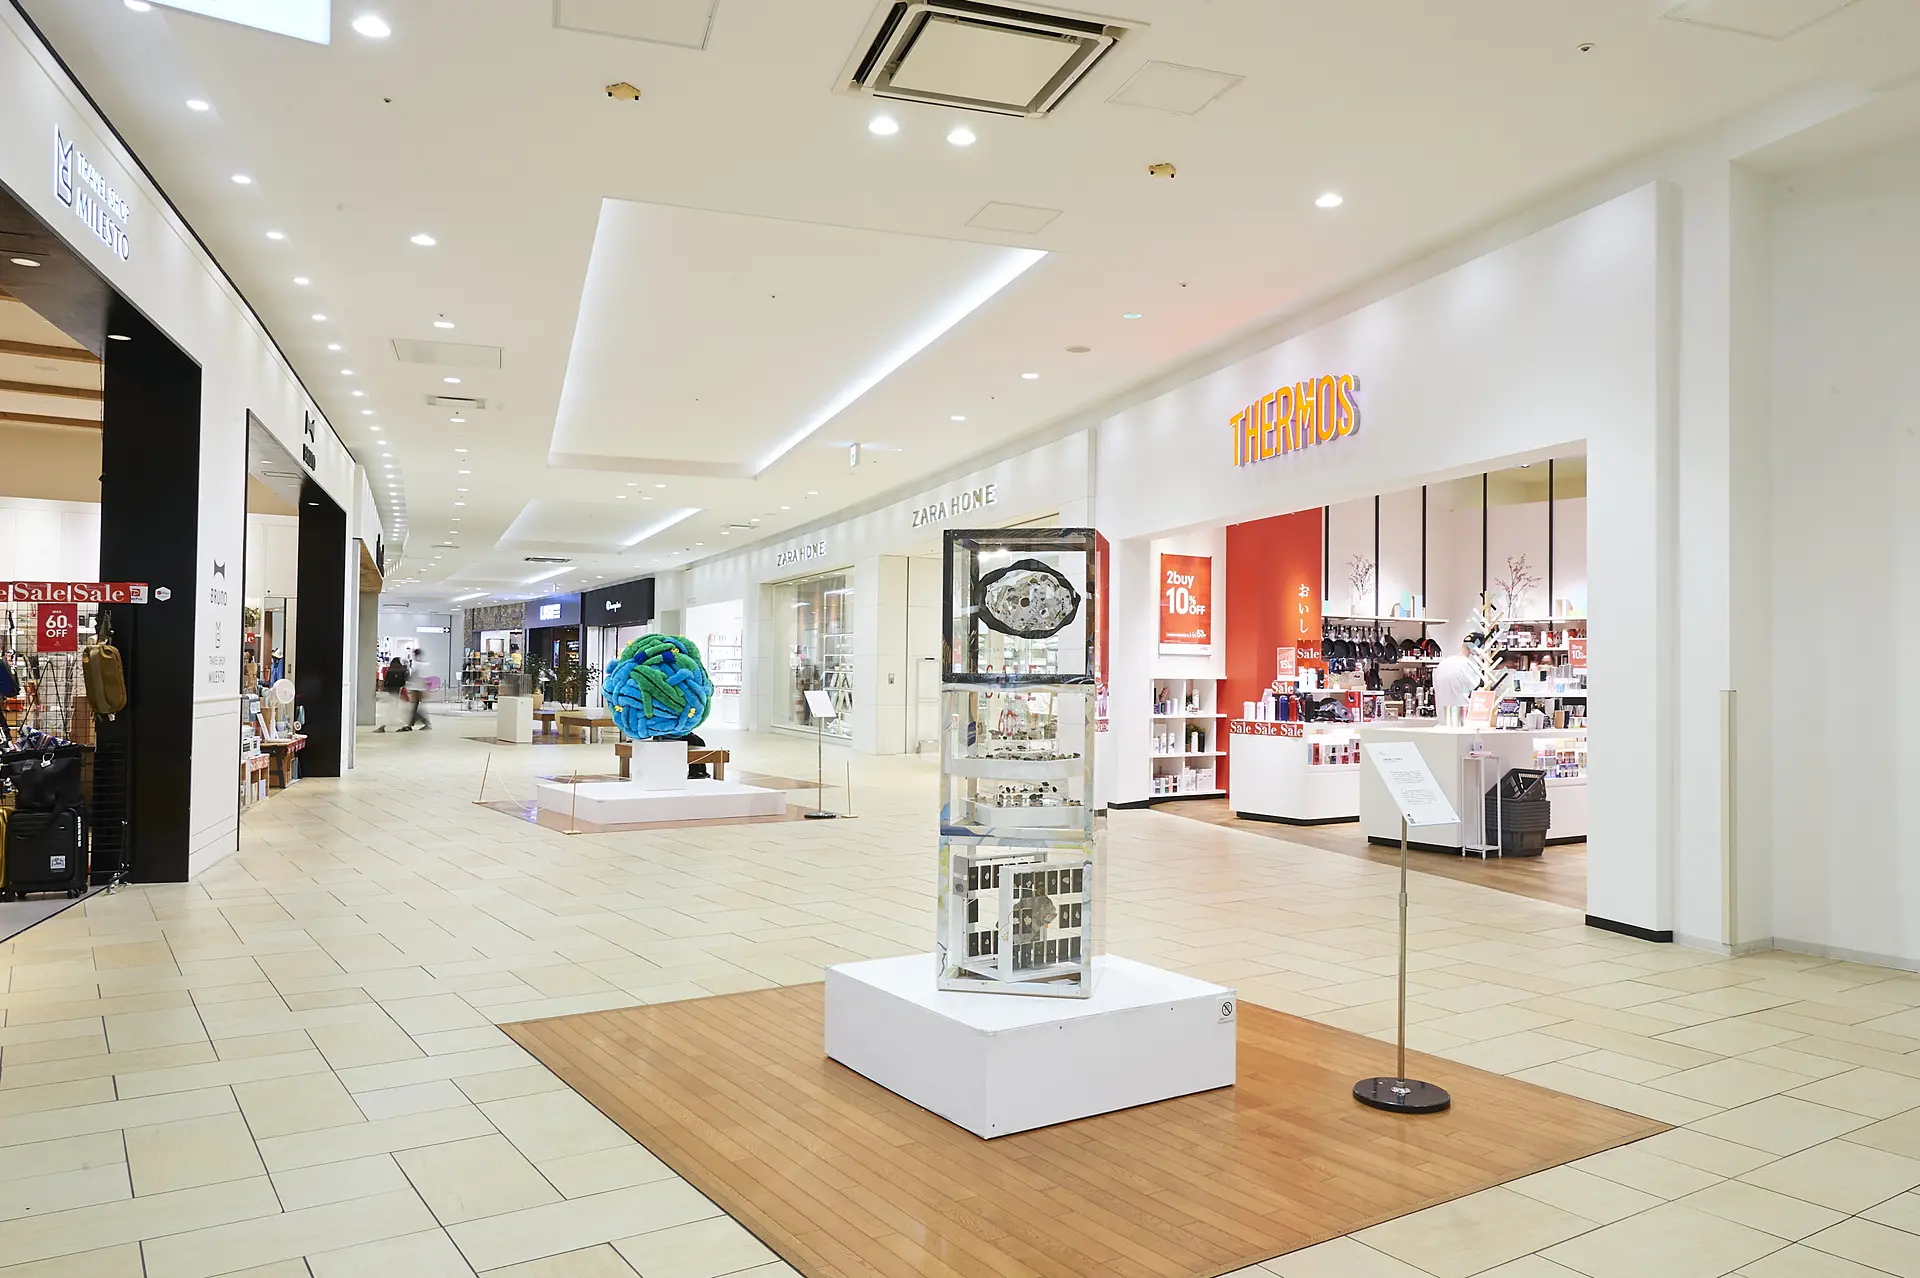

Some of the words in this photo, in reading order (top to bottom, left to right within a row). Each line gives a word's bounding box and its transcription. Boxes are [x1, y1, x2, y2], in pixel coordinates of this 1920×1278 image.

[77, 151, 107, 202] TRAVEL
[108, 187, 130, 224] SHOP
[75, 187, 129, 261] MILESTO
[1230, 373, 1357, 467] THERMOS
[912, 502, 948, 528] ZARA
[951, 484, 997, 515] HOME
[777, 550, 799, 567] ZARA
[1166, 570, 1194, 588] 2buy
[14, 582, 66, 601] Sale
[73, 583, 125, 602] Sale
[1189, 605, 1206, 615] OFF
[1298, 583, 1310, 642] おいし
[45, 615, 73, 629] 60%
[46, 629, 68, 638] OFF
[1297, 648, 1320, 659] Sale
[1271, 682, 1294, 694] Sale
[1230, 721, 1252, 734] Sale
[1254, 722, 1277, 735] Sale
[1280, 724, 1303, 737] Sale
